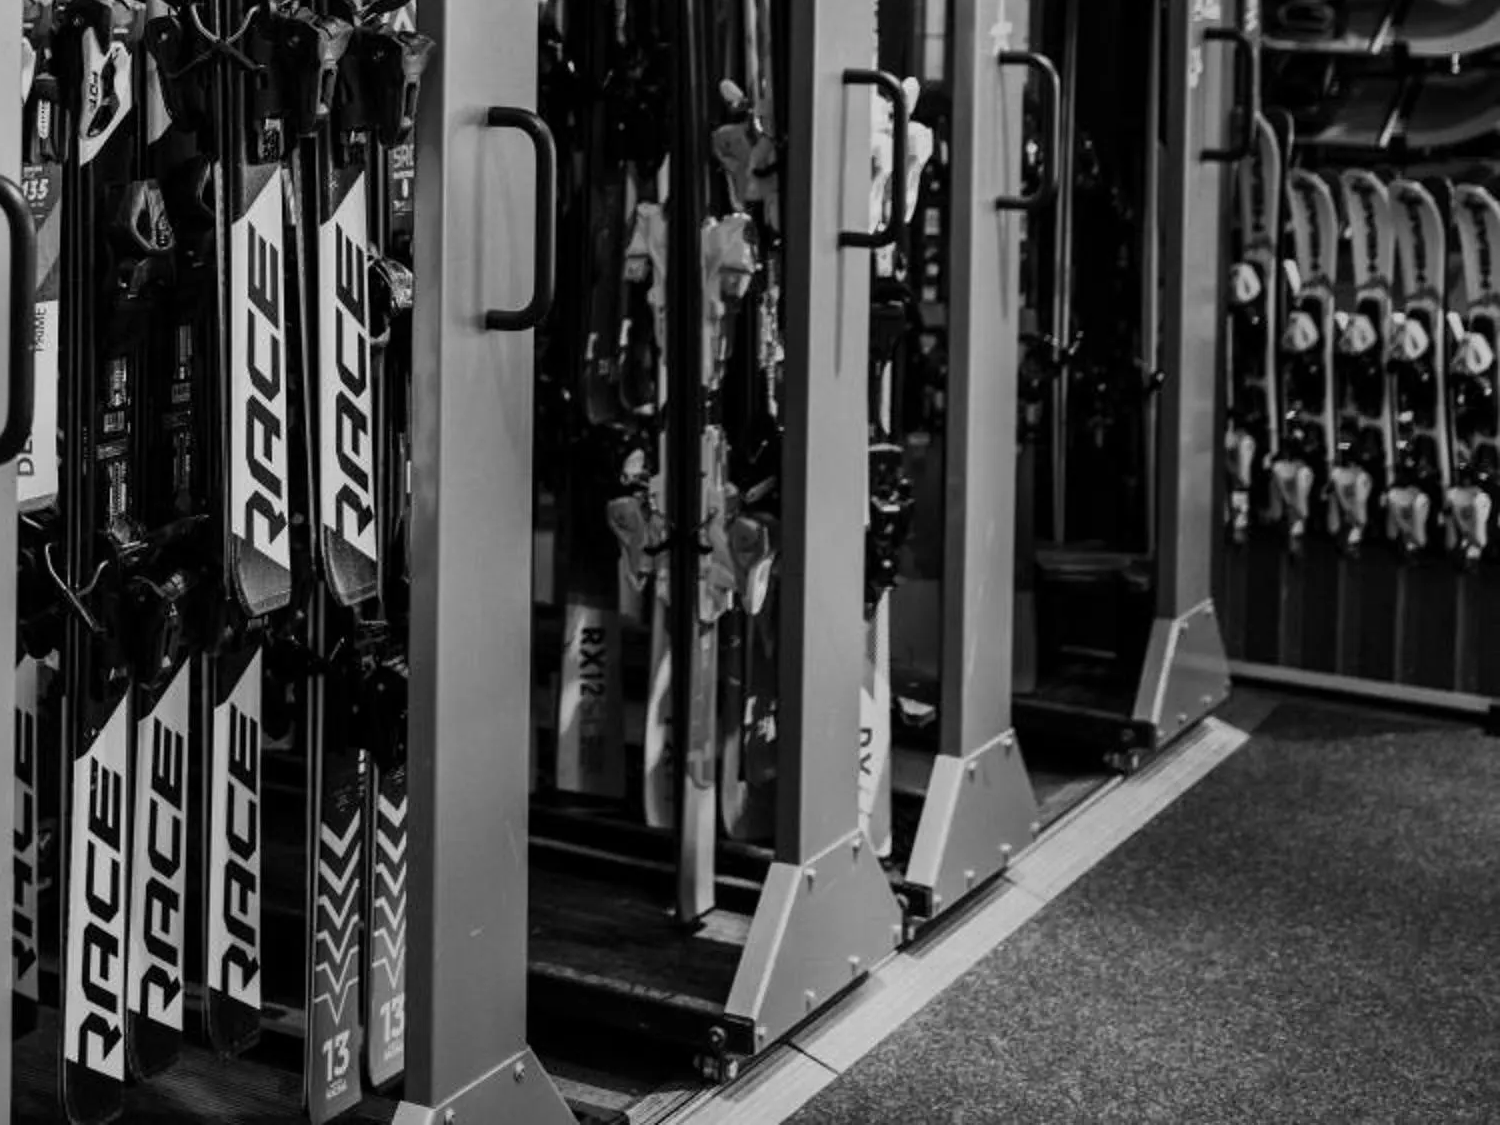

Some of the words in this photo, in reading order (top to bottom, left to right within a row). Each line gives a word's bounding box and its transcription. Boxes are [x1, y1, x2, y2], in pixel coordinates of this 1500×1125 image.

[245, 222, 288, 552] RACE
[335, 222, 374, 548] RACE
[78, 756, 123, 1068] RACE
[140, 717, 185, 1024] RACE
[222, 703, 261, 997] RACE
